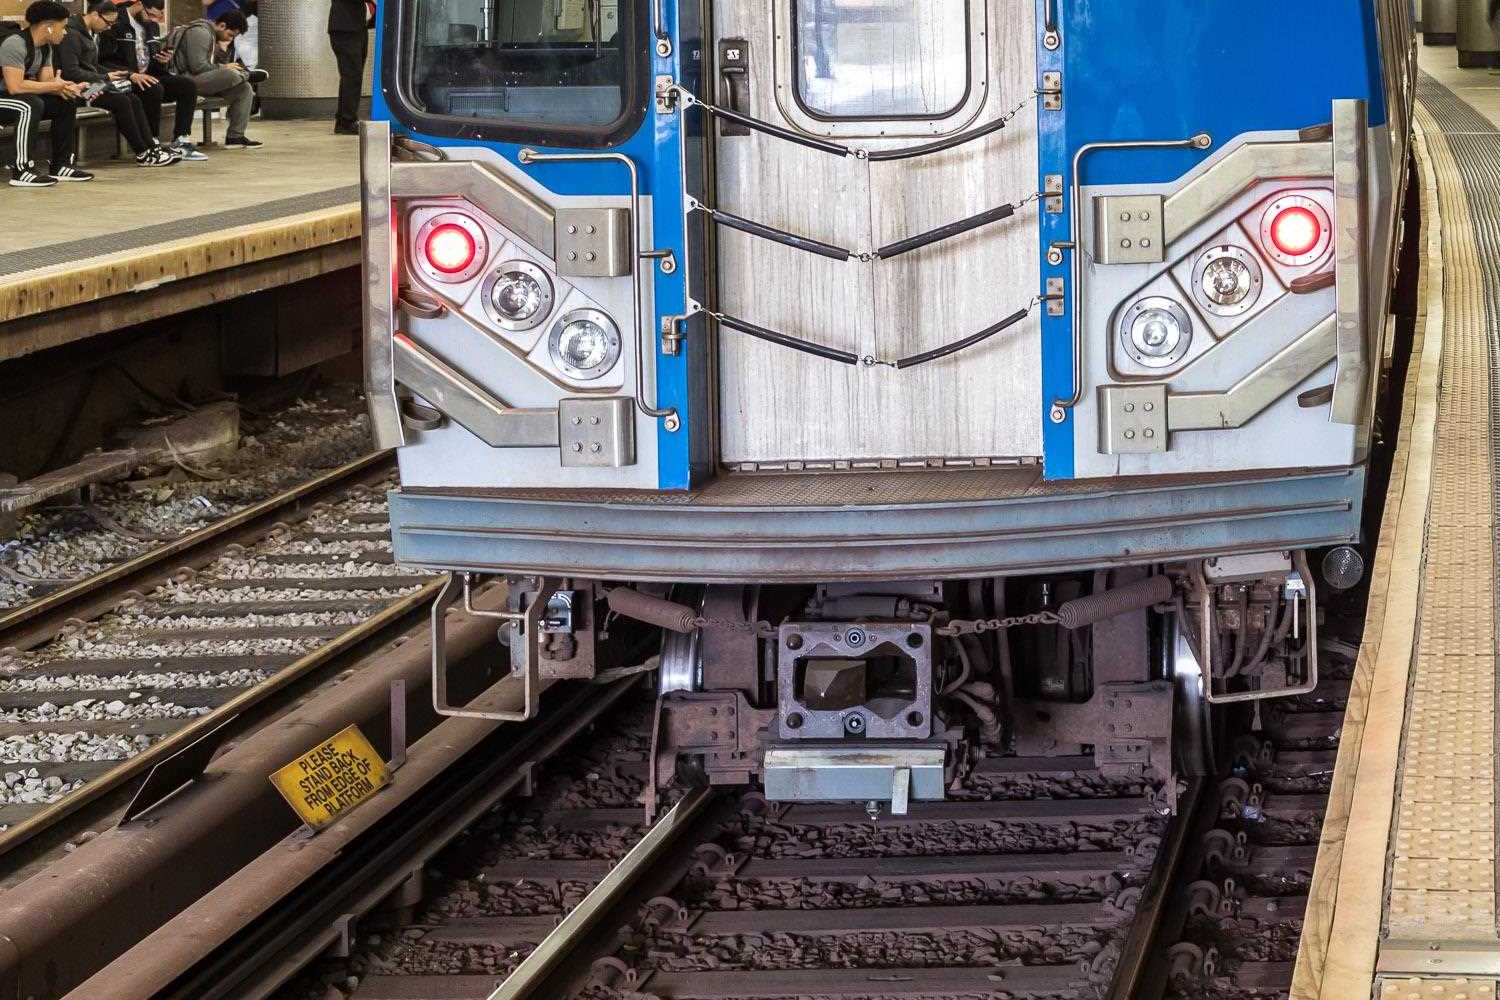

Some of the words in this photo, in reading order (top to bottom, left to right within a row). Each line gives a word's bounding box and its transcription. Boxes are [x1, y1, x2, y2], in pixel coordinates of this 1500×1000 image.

[298, 743, 340, 775] PLEASE
[300, 766, 333, 794] STAND
[329, 748, 359, 775] BACK
[304, 785, 335, 810] FROM
[331, 767, 359, 792] EDGE
[356, 758, 372, 776] OF
[323, 777, 375, 816] PLATFORM
